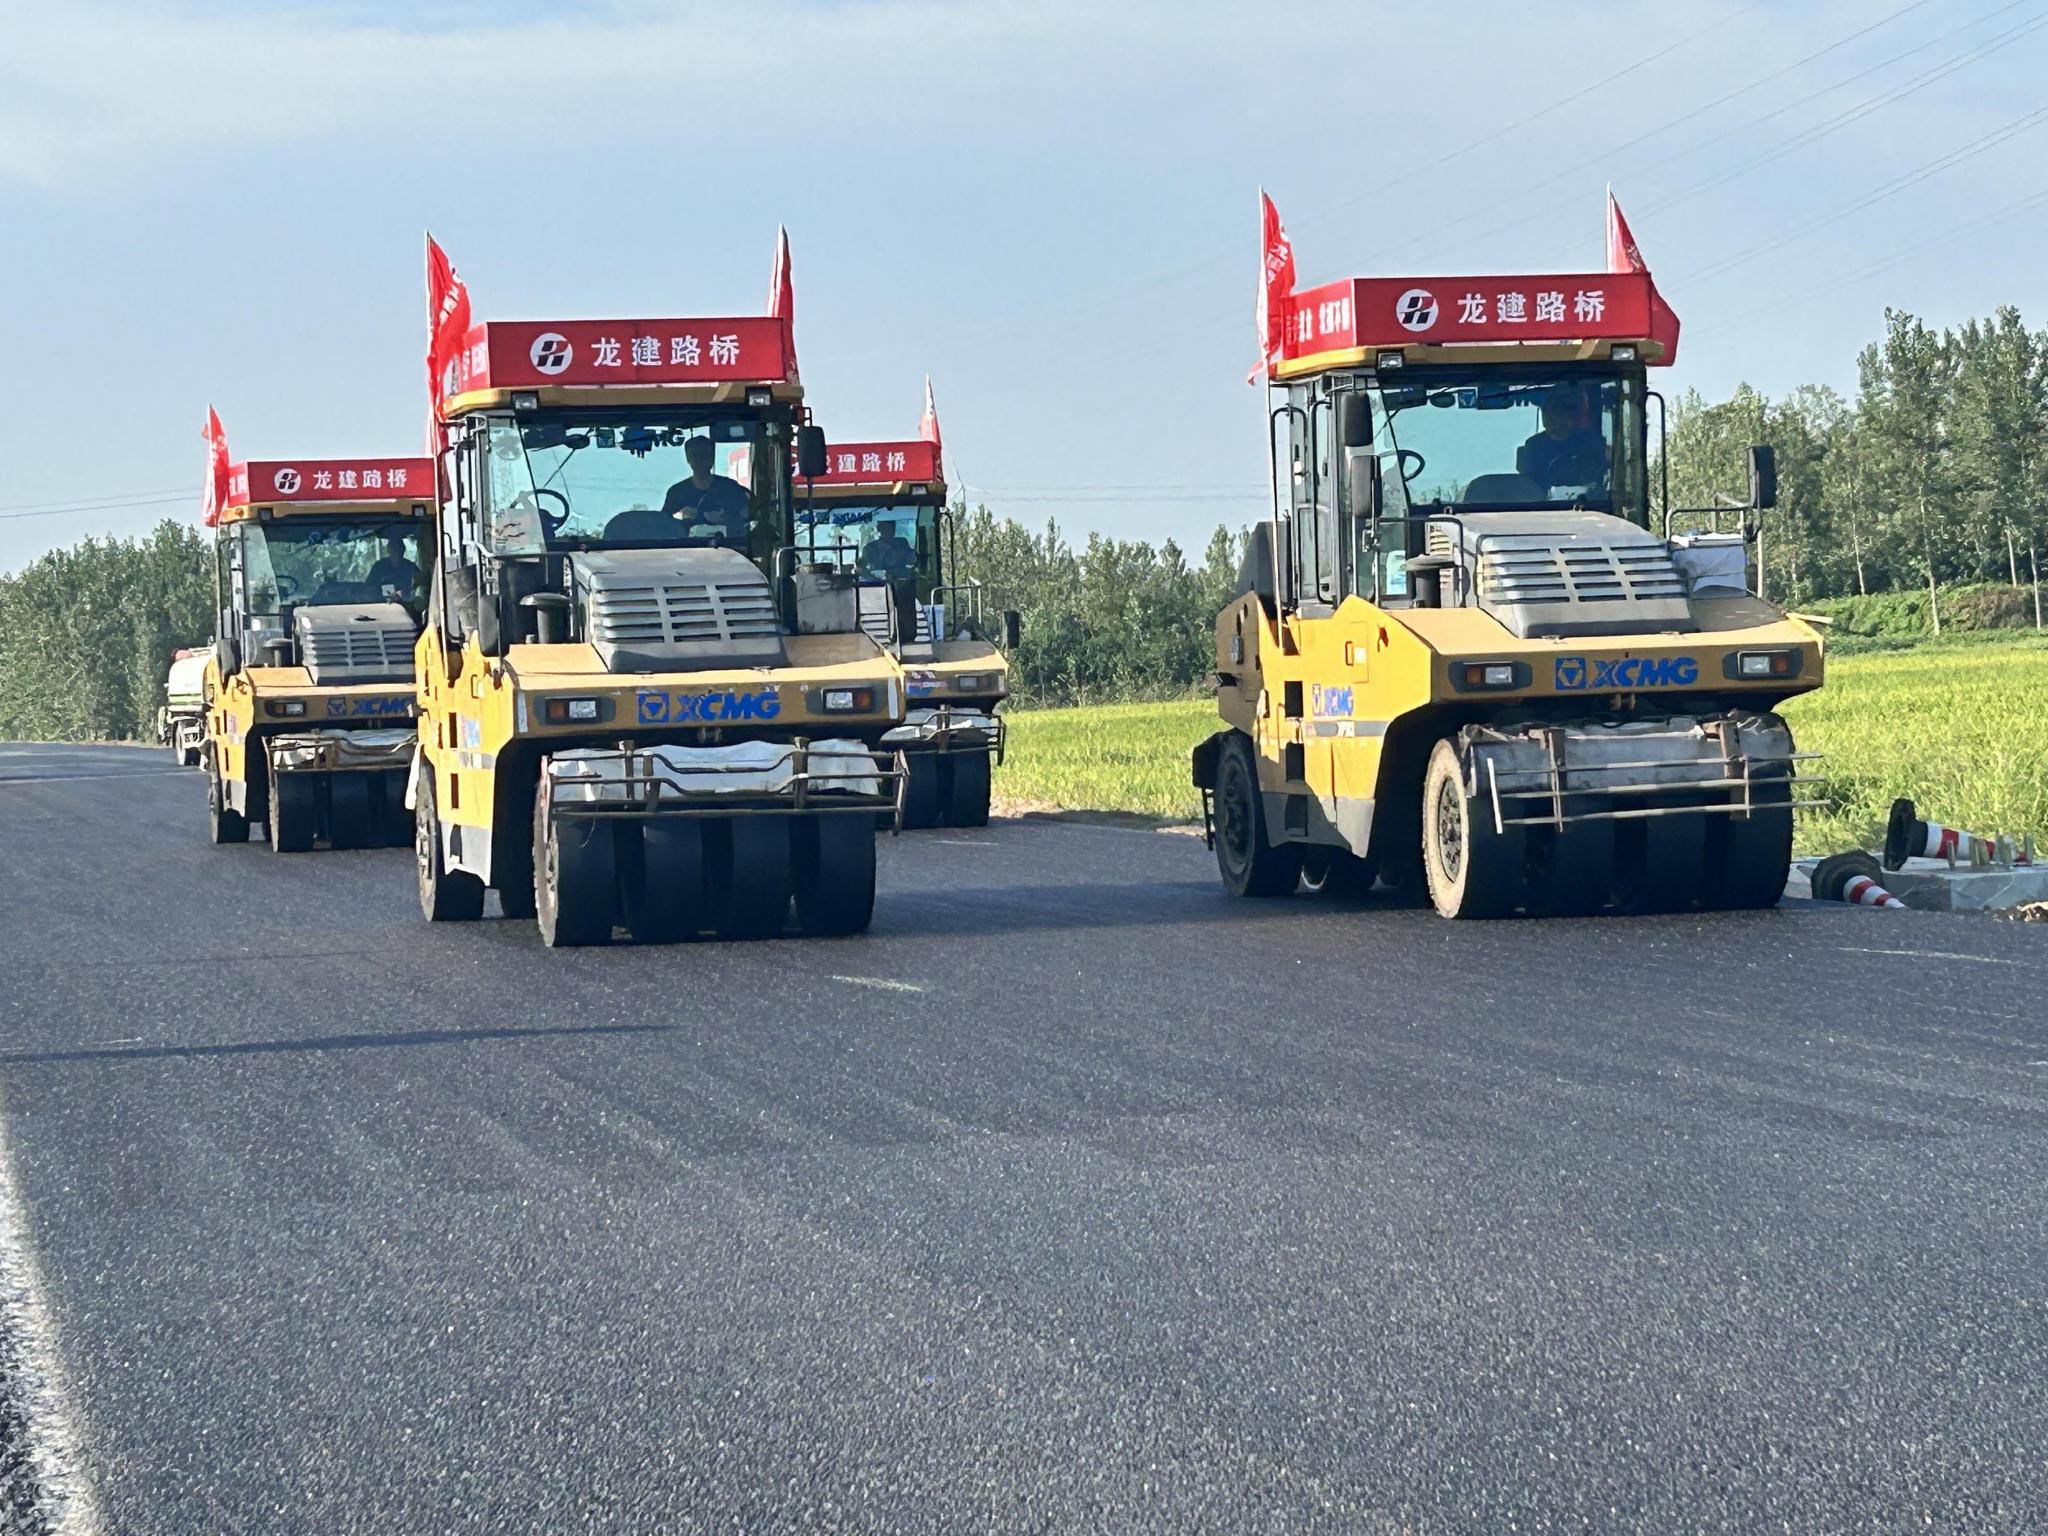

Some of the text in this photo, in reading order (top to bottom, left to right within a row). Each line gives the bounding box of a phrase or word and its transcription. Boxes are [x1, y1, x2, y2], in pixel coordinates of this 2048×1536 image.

[1458, 290, 1605, 324] 龙建路桥
[591, 334, 740, 367] 龙建路桥
[313, 468, 407, 489] 龙建路桥
[1592, 657, 1698, 688] XCMG
[676, 691, 781, 721] XCMG
